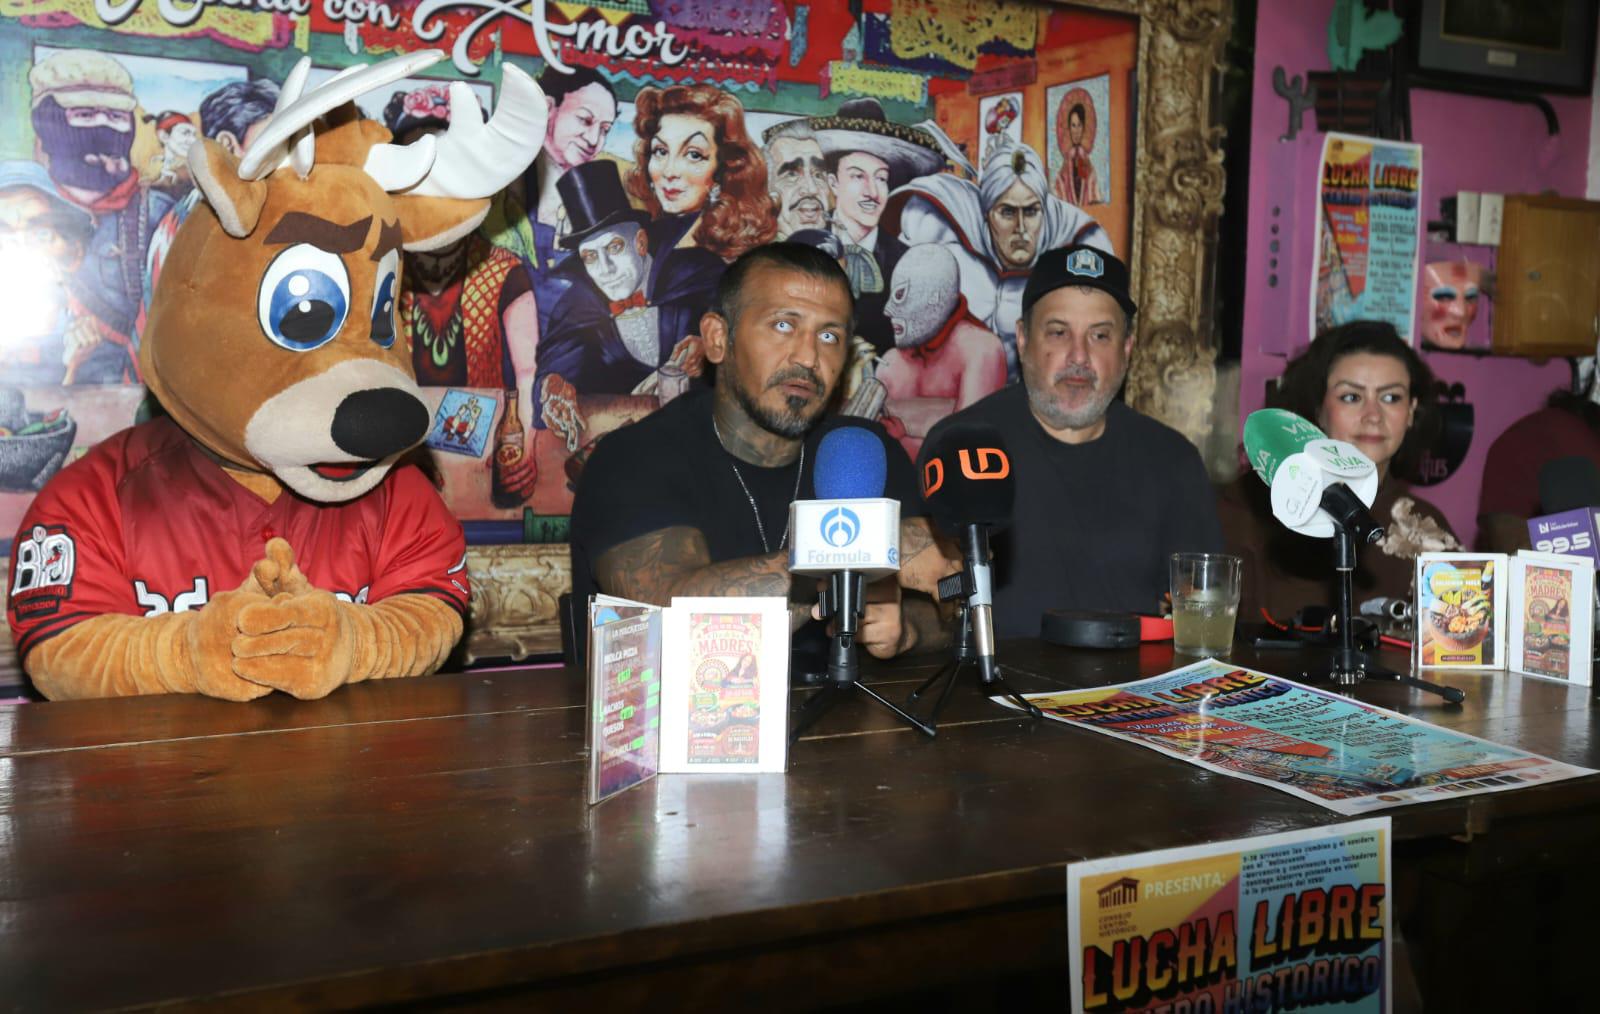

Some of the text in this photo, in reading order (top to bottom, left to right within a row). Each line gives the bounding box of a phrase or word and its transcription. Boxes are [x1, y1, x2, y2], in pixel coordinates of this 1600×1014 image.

[412, 0, 688, 75] Amor
[1322, 161, 1420, 191] LUCHA LIBRE
[807, 549, 872, 563] Fórmula
[1536, 532, 1591, 553] 99.5
[699, 638, 753, 656] MADRES
[1042, 695, 1166, 717] LUCHA
[1152, 669, 1268, 704] LIBRE
[1083, 883, 1386, 1011] LUCHA LIBRE
[1224, 955, 1384, 1013] HISTORICO
